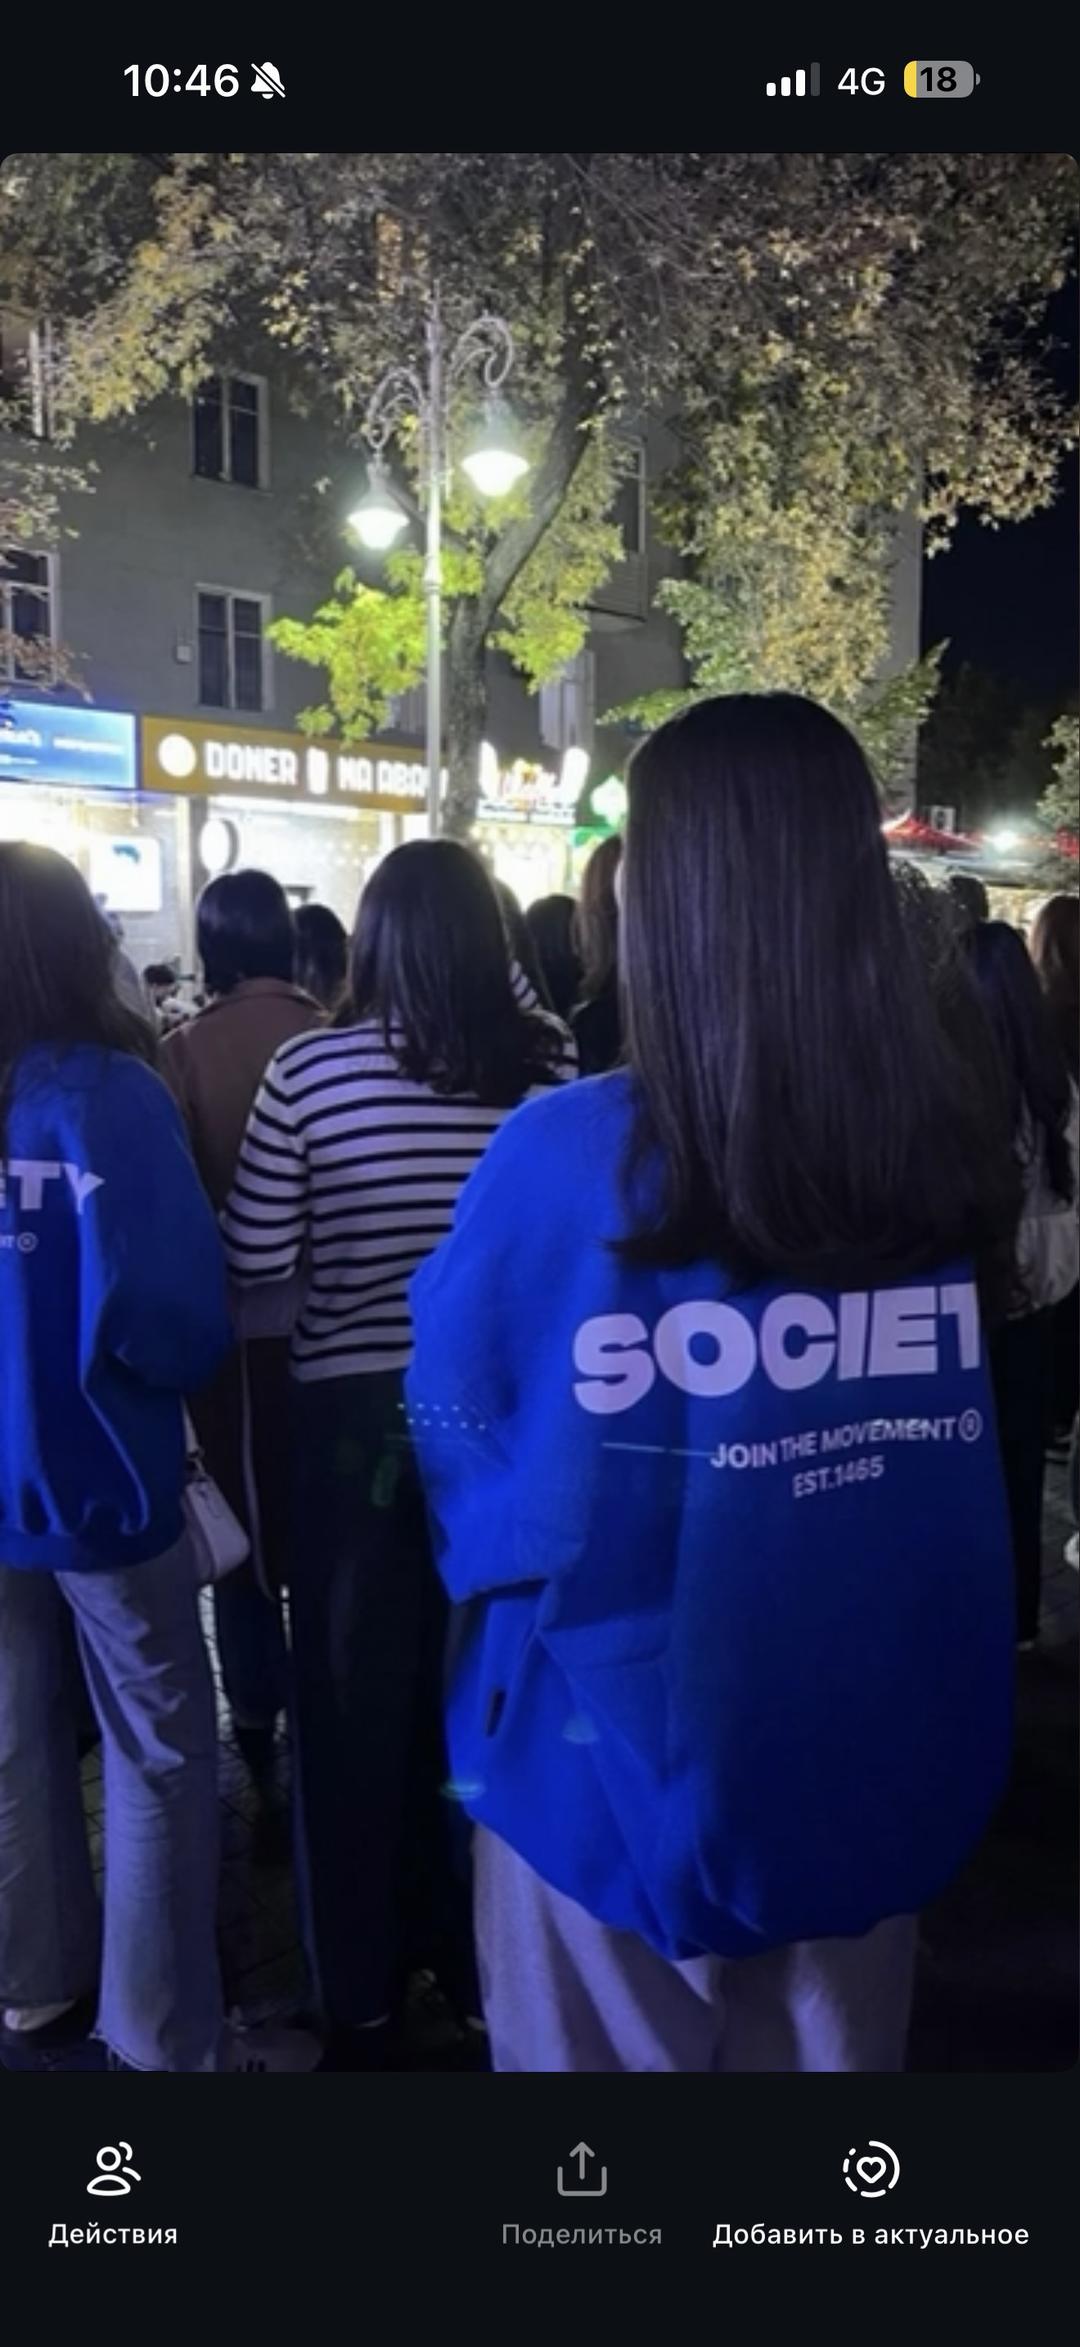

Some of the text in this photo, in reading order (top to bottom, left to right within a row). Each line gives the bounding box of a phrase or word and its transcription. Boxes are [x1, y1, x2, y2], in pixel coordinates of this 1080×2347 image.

[203, 740, 299, 786] DONER
[0, 1159, 105, 1215] TY
[710, 1441, 778, 1468] JOIN
[780, 1431, 818, 1462] THE
